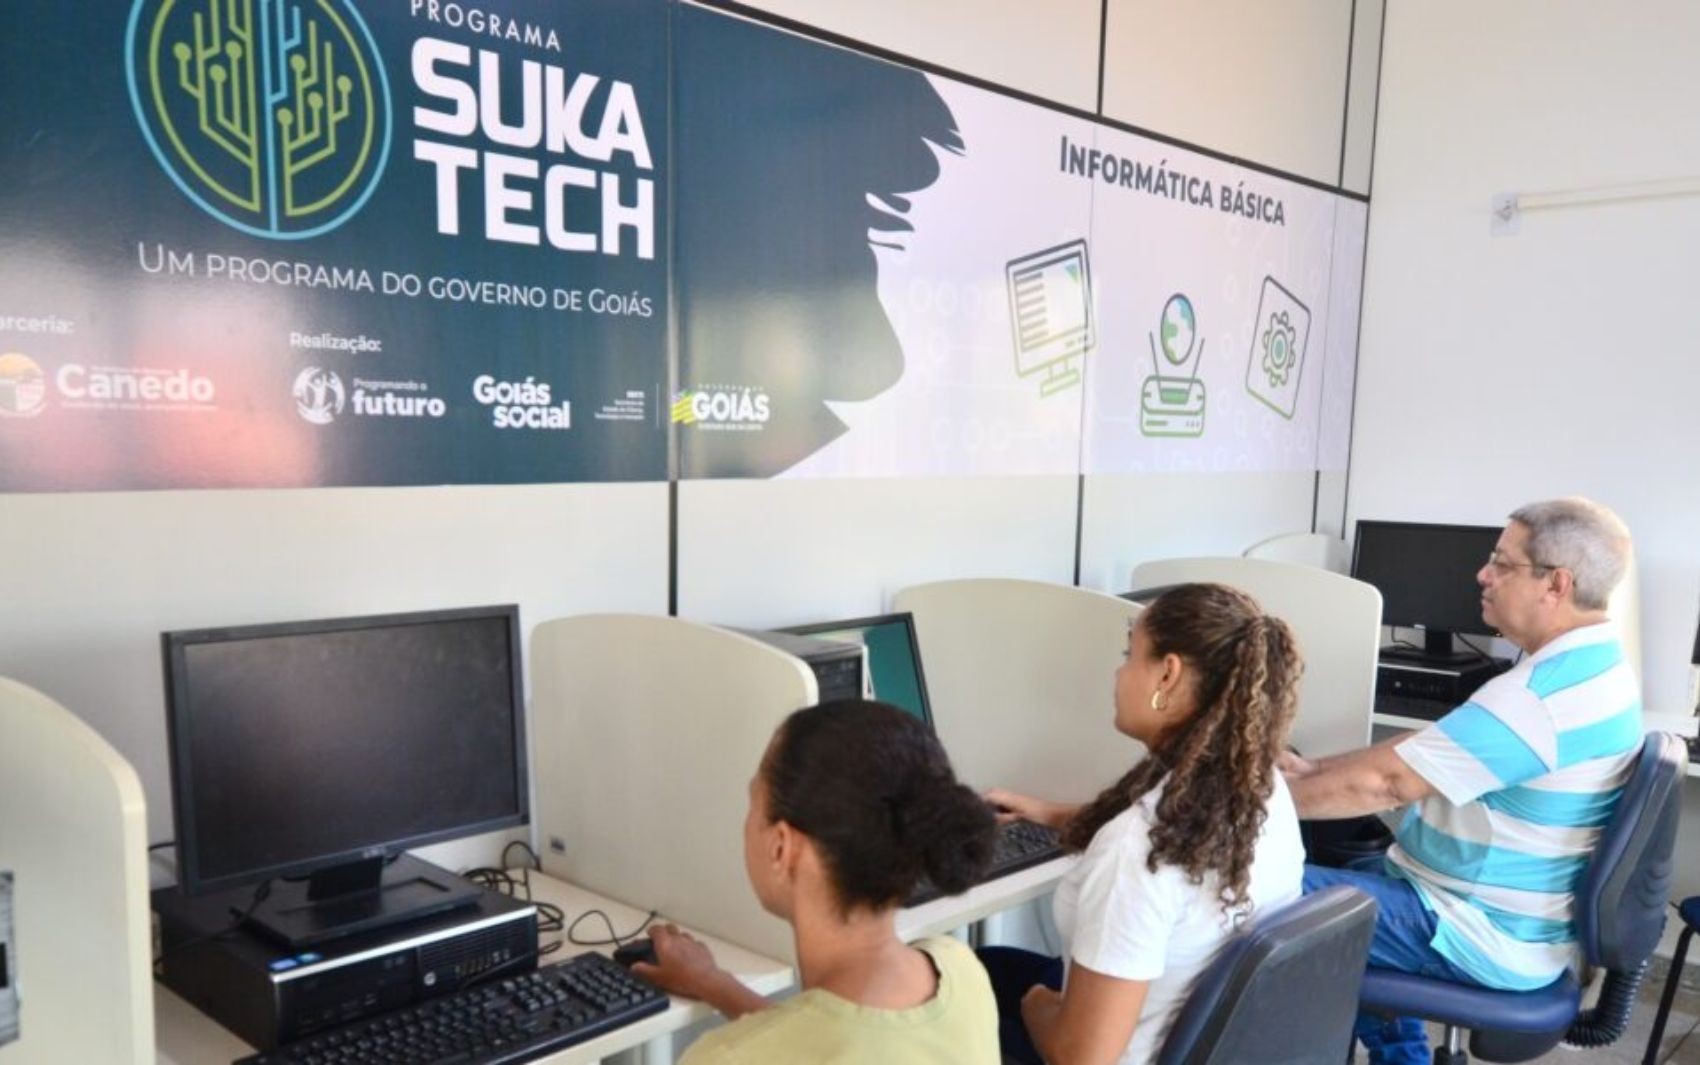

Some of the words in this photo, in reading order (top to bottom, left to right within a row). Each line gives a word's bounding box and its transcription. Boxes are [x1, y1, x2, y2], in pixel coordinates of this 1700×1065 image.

[410, 0, 562, 52] PROGRAMA
[411, 36, 653, 170] SUKA
[413, 138, 654, 260] TECH
[1059, 135, 1214, 209] INFORMÁTICA
[1219, 181, 1286, 227] BÁSICA
[206, 254, 375, 293] PROGRAMA
[382, 271, 421, 296] DO
[428, 276, 546, 308] GOVERNO
[553, 289, 583, 311] DE
[0, 315, 75, 334] arceria:
[289, 332, 382, 354] Realização:
[56, 363, 216, 402] Canedo
[473, 374, 551, 405] Goiás
[352, 389, 447, 417] futuro
[492, 400, 571, 429] social
[692, 388, 770, 422] GOIÁS
